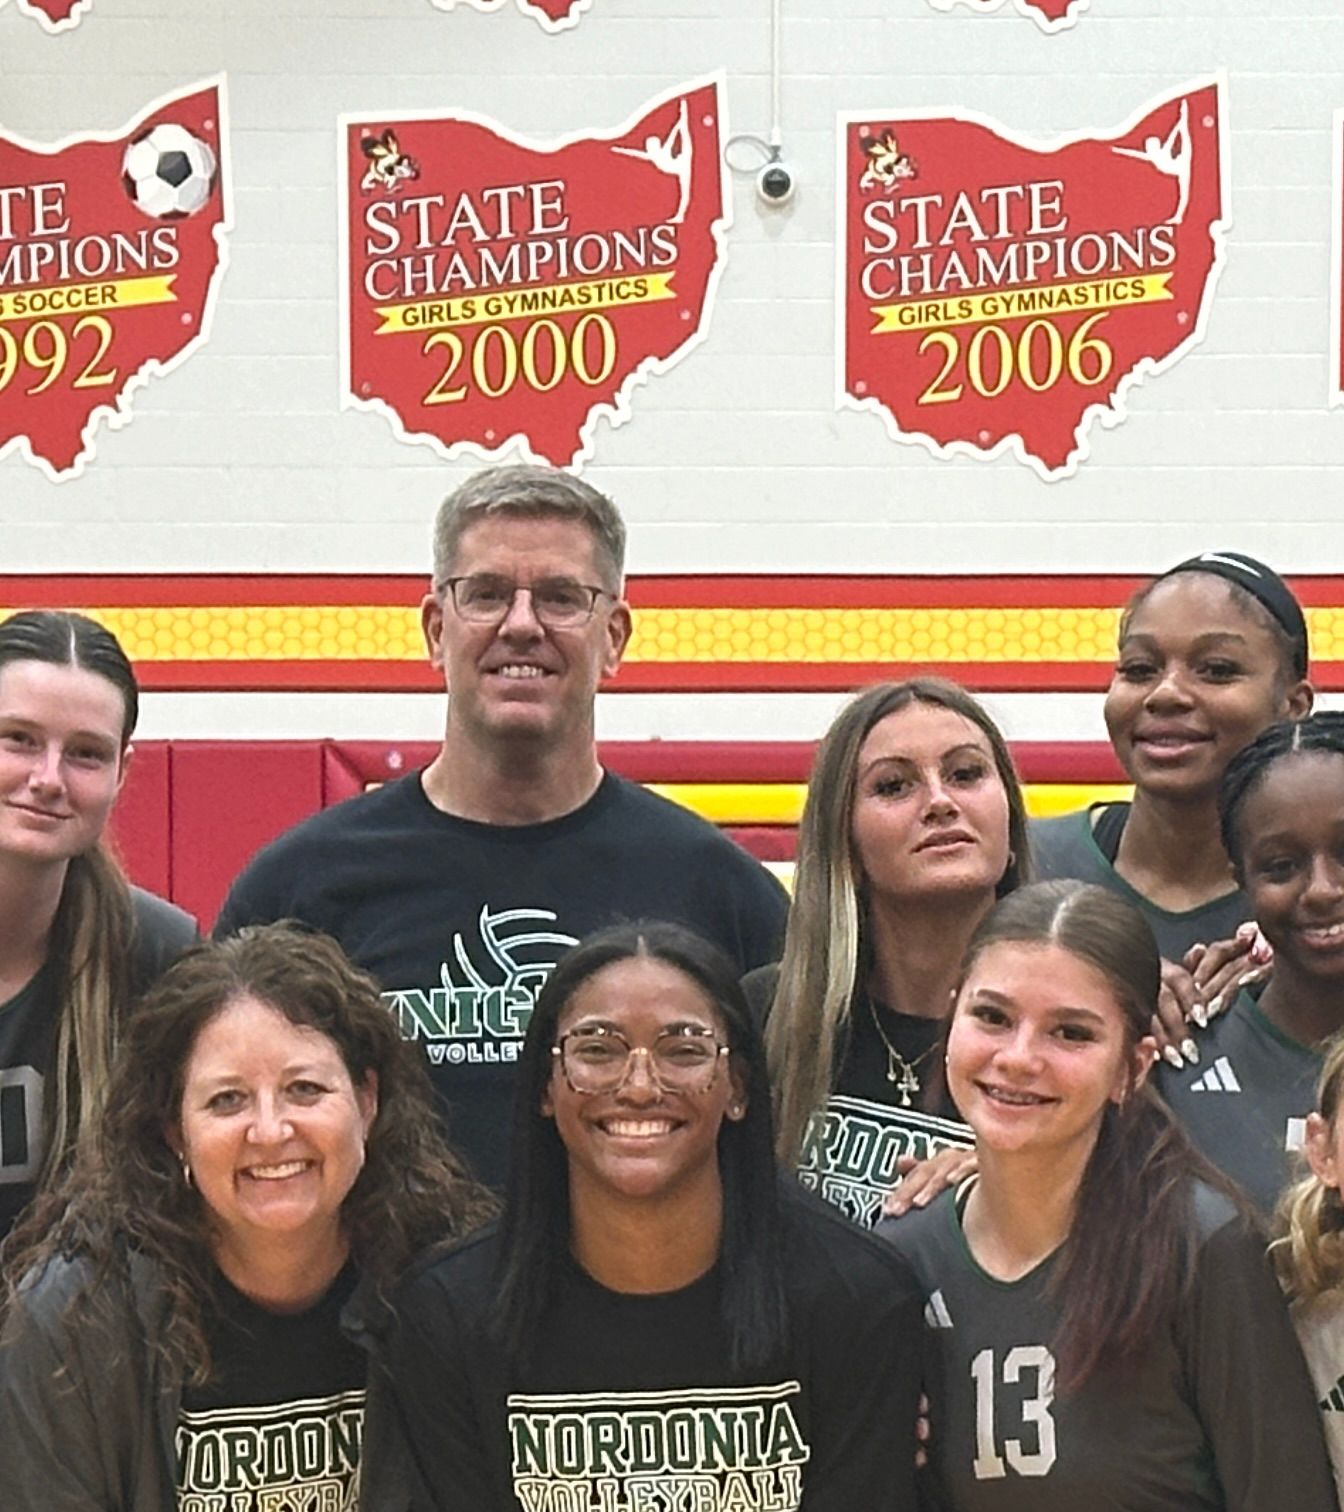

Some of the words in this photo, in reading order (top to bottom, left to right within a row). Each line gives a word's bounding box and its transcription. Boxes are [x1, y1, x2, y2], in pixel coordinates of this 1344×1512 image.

[366, 180, 569, 255] STATE
[864, 180, 1067, 254] STATE
[14, 285, 117, 314] SOCCER
[365, 226, 678, 300] CHAMPIONS
[862, 227, 1175, 299] CHAMPIONS
[402, 300, 476, 326] GIRLS
[484, 279, 648, 315] GYMNASTICS
[898, 300, 972, 325] GIRLS
[981, 280, 1145, 315] GYMNASTICS
[423, 313, 616, 405] 2000
[918, 312, 1111, 405] 2006
[380, 970, 547, 1040] NIG
[427, 1041, 525, 1064] VOLLE
[509, 1402, 810, 1477] NORDONIA
[971, 1346, 1056, 1479] 13
